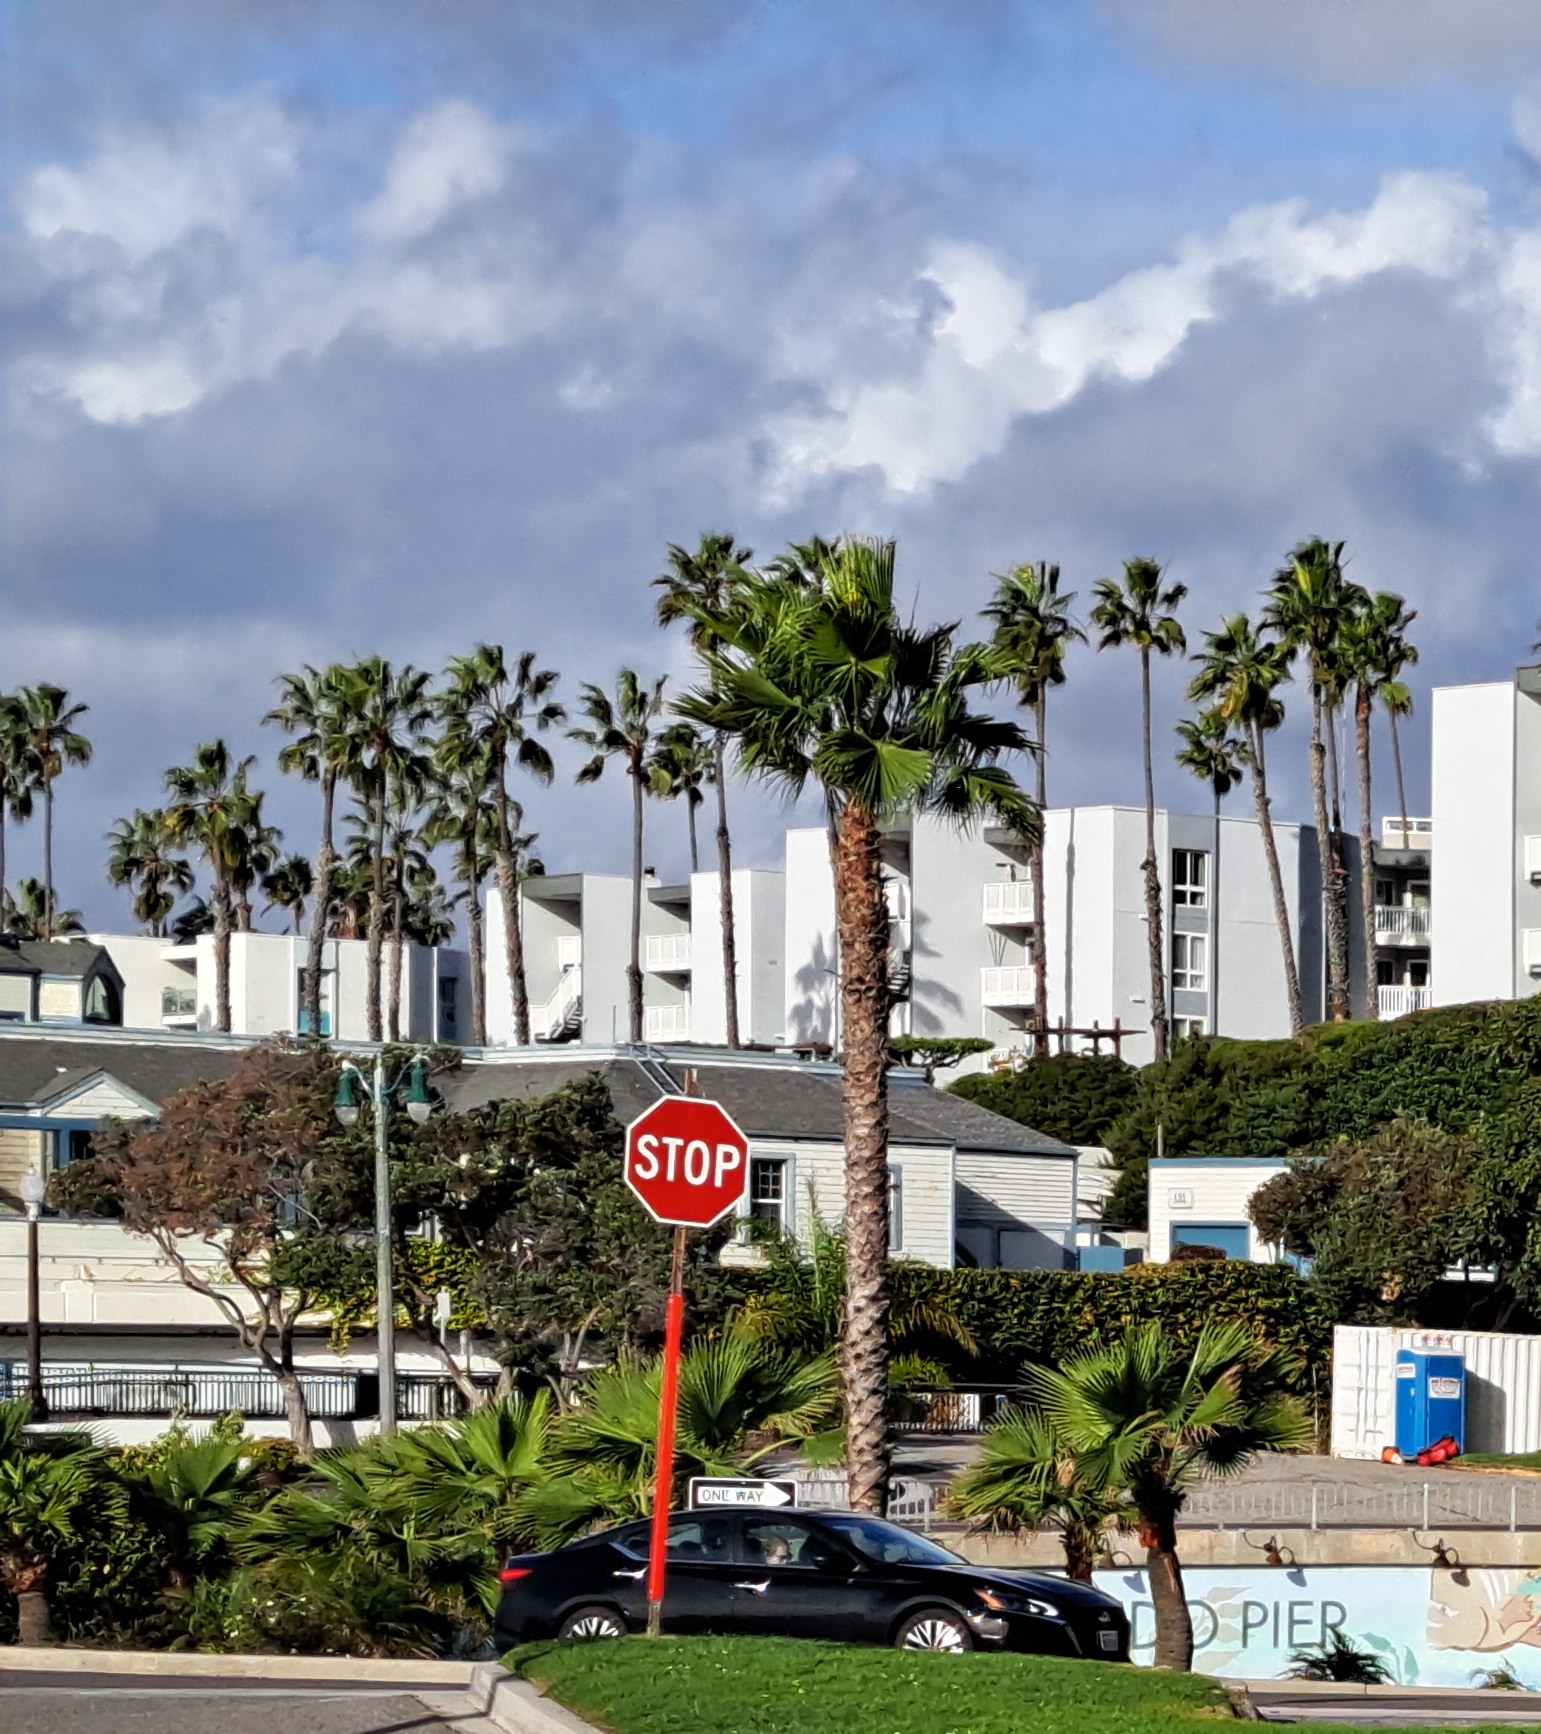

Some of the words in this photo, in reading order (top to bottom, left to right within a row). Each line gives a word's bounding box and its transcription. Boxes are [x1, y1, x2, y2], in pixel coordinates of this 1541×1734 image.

[634, 1134, 740, 1188] STOP
[735, 1490, 765, 1502] WAY
[1242, 1599, 1348, 1649] PIER
